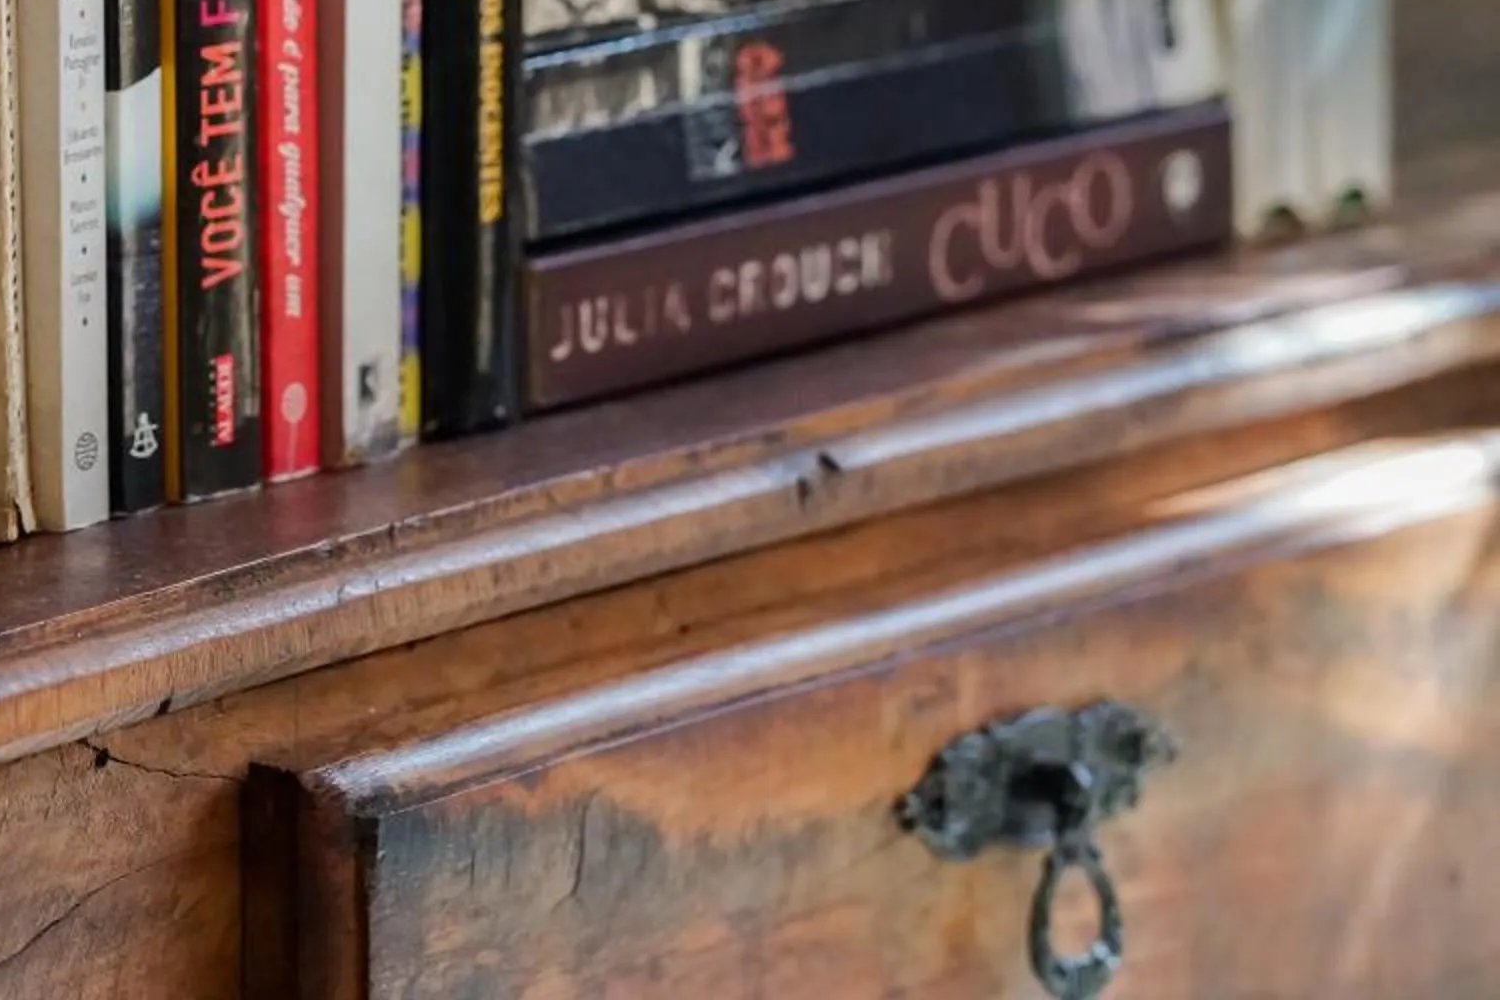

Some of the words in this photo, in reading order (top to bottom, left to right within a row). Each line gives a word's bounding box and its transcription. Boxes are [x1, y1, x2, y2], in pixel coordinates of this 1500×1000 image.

[200, 42, 243, 148] TEM
[277, 62, 300, 134] para
[192, 153, 245, 290] VOCÊ
[278, 142, 307, 267] qualquer
